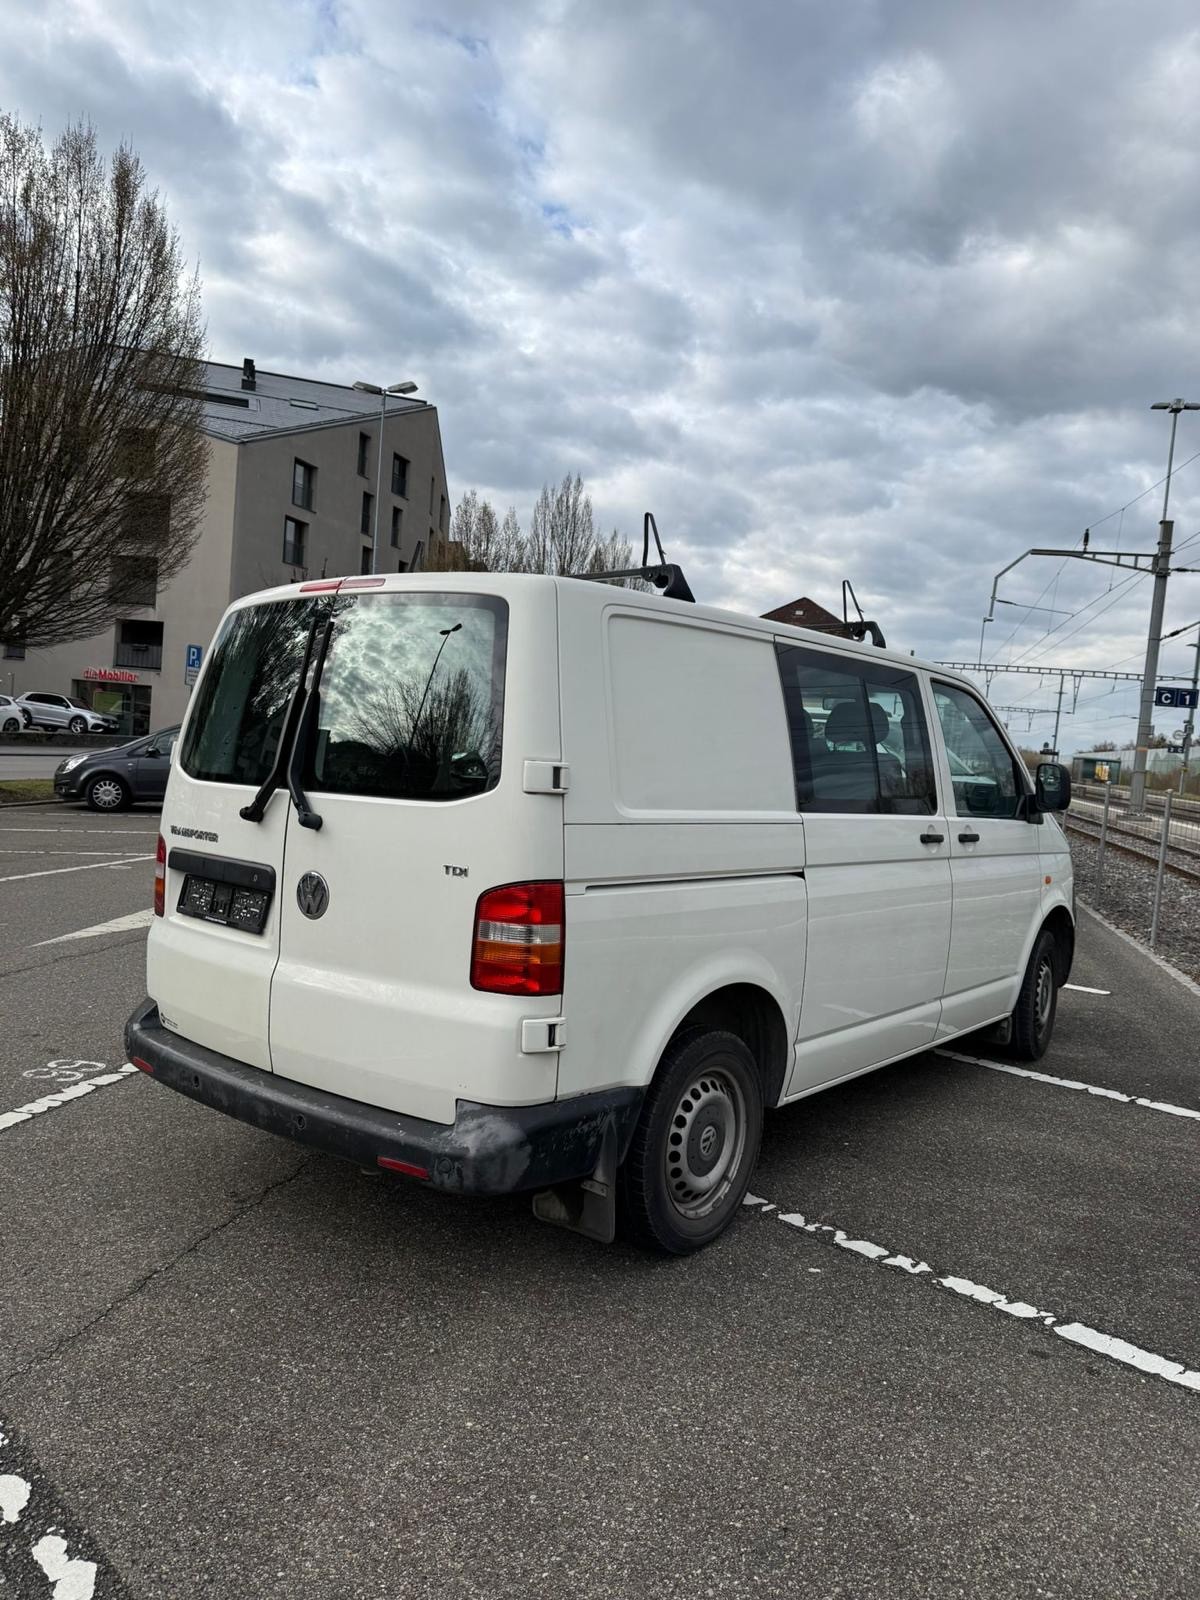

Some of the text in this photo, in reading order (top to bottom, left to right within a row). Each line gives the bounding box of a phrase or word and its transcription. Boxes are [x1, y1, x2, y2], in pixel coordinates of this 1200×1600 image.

[190, 647, 198, 665] P
[1161, 693, 1190, 705] C 1
[443, 864, 469, 878] TDI
